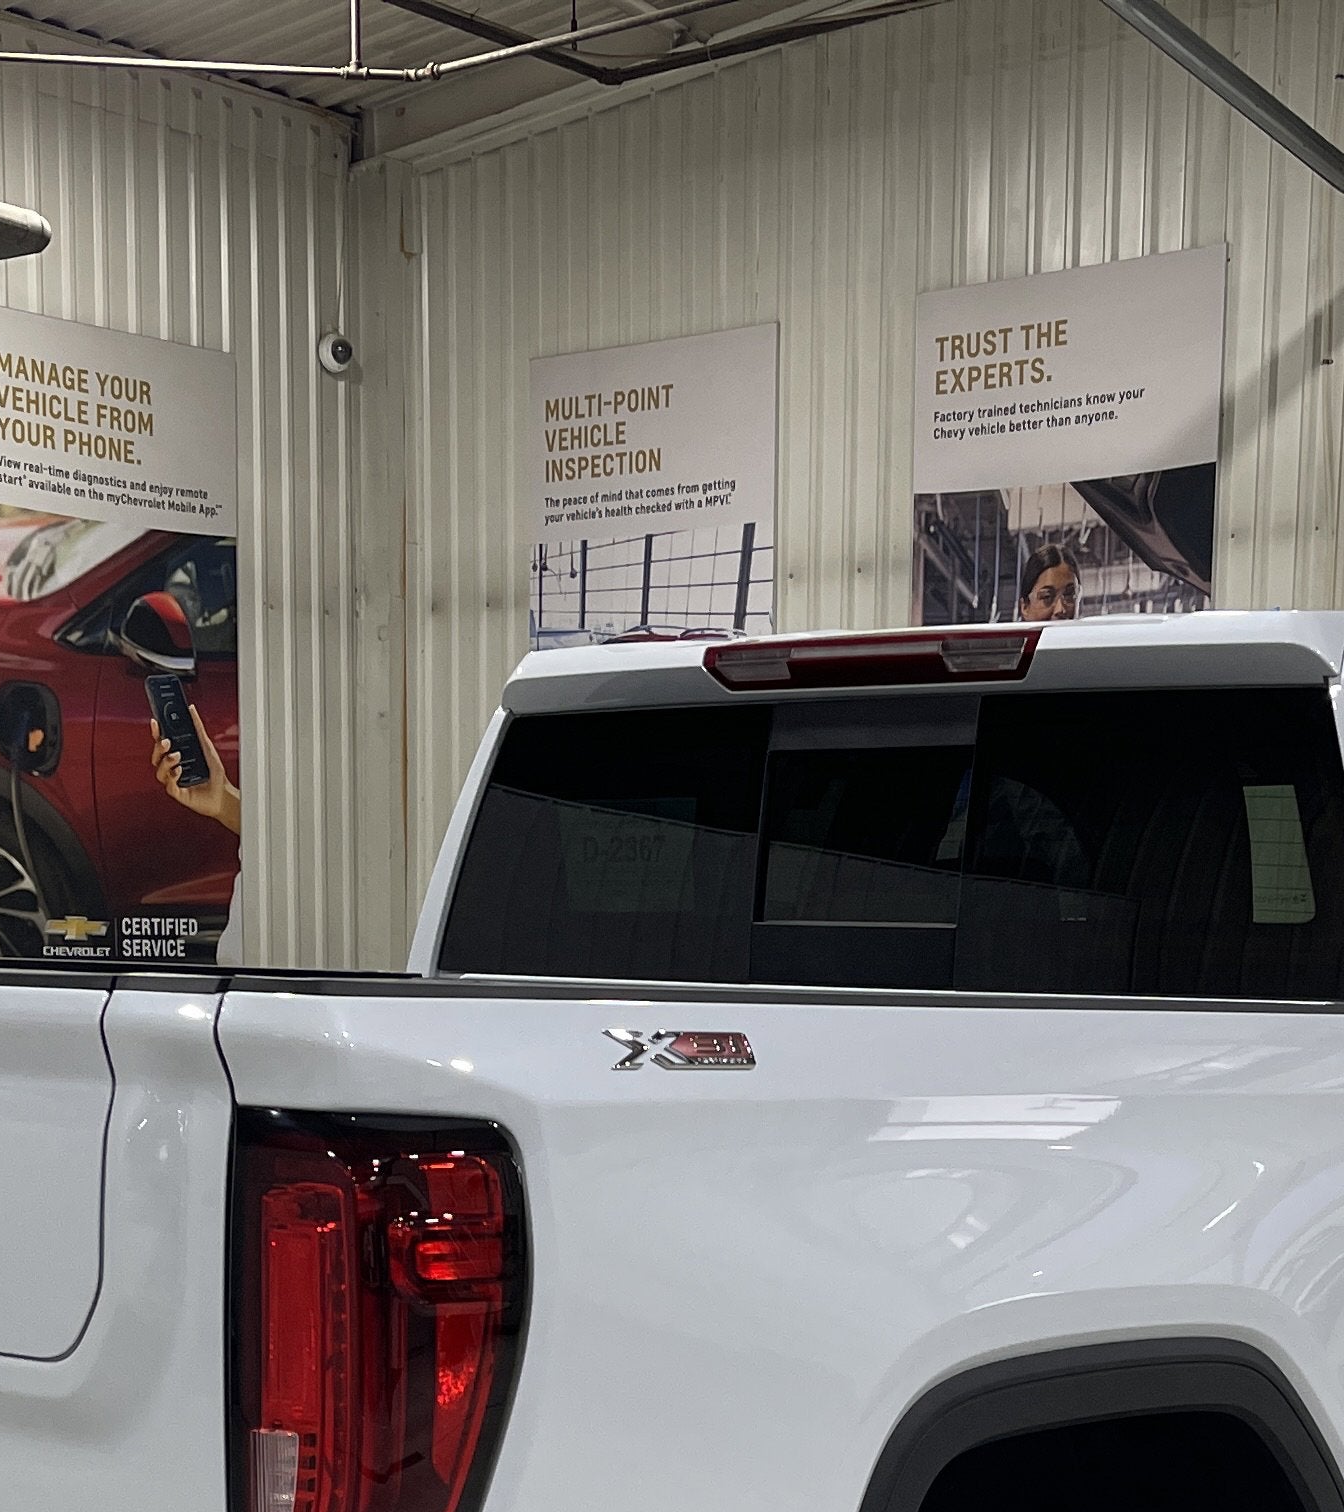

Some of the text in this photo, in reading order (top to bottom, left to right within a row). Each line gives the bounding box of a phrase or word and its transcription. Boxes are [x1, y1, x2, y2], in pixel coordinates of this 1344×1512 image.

[935, 319, 1068, 363] TRUST THE
[95, 371, 152, 406] YOUR
[935, 357, 1053, 396] EXPERTS.
[96, 404, 154, 437] FROM
[544, 383, 674, 424] MULTI-POINT
[933, 387, 1145, 423] Factory trained technicians know your
[544, 421, 627, 453] VEHICLE
[933, 409, 1119, 441] Chevy vehicle better than anyone.
[64, 429, 142, 465] PHONE.
[23, 461, 70, 480] real-time
[72, 469, 127, 490] diagnostics
[130, 480, 147, 493] and
[149, 484, 174, 498] enjoy
[175, 487, 208, 500] remote
[545, 448, 662, 483] INSPECTION
[28, 478, 72, 496] available
[74, 488, 86, 498] on
[88, 488, 104, 501] the
[106, 492, 166, 511] myChevrolet
[167, 500, 197, 515] Mobile
[544, 478, 736, 510] The peace of mind that comes from getting
[544, 513, 564, 527] your
[566, 507, 603, 522] vehicle's
[605, 505, 633, 518] health
[635, 501, 672, 515] checked
[674, 498, 694, 511] with
[697, 499, 703, 509] a
[121, 917, 198, 937] CERTIFIED
[43, 945, 111, 957] CHEVROLET
[122, 939, 186, 957] SERVICE
